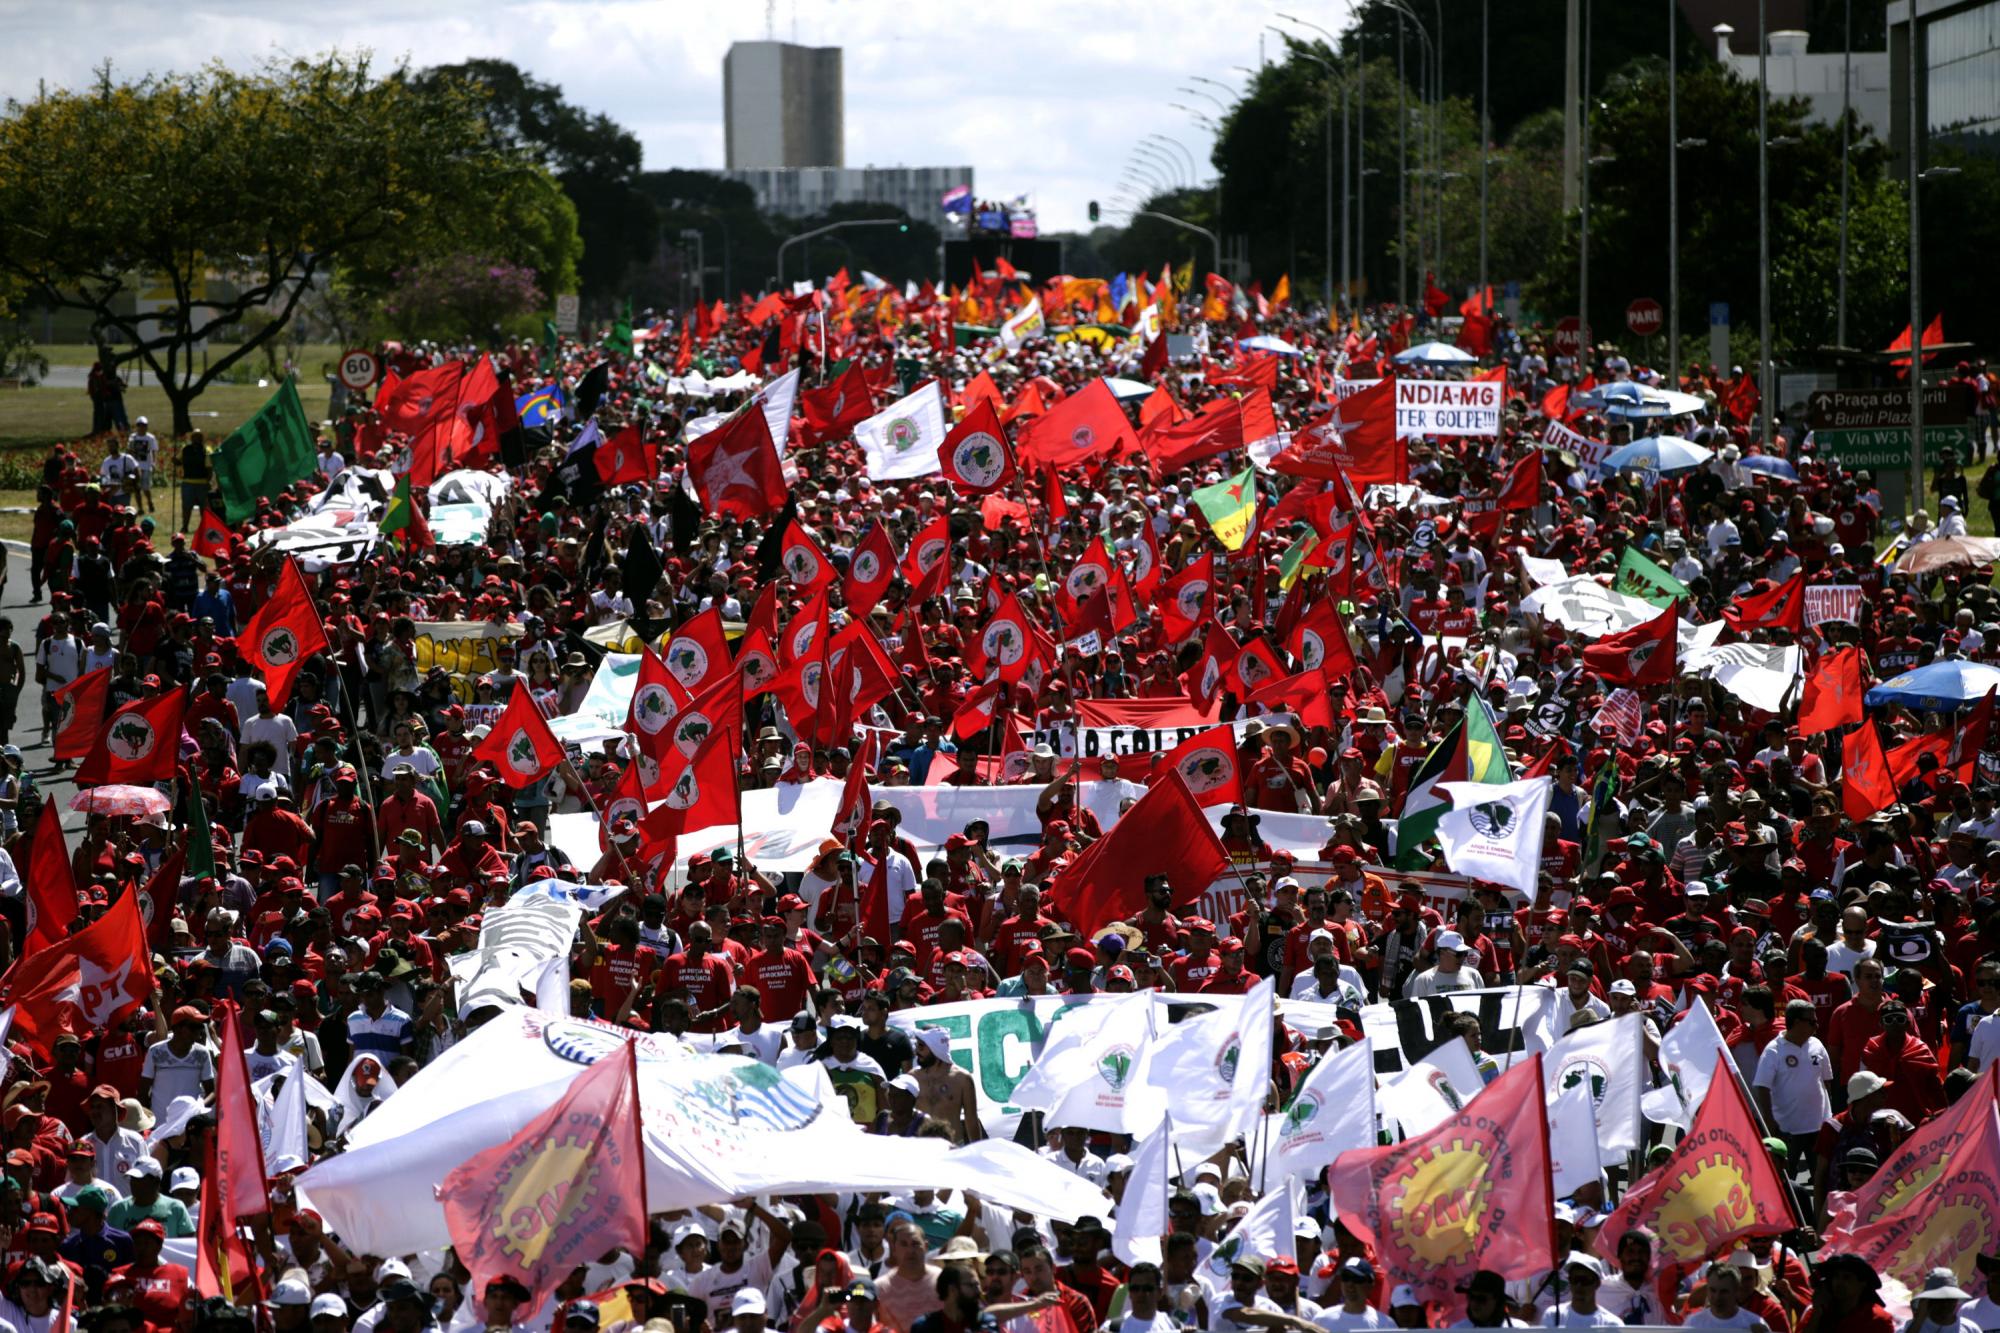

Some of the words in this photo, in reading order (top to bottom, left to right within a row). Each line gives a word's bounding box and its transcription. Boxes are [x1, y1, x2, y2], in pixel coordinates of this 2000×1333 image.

[1628, 310, 1661, 325] PARE
[346, 358, 370, 375] 60
[1834, 394, 1875, 409] Praça
[1882, 393, 1903, 406] do
[1397, 408, 1427, 428] TER
[1435, 409, 1496, 429] GOLPE!!!
[1835, 411, 1873, 426] Buriti
[1846, 433, 1870, 446] Via
[1874, 431, 1899, 445] W3
[1903, 429, 1946, 445] Nrte
[81, 968, 122, 1018] PT
